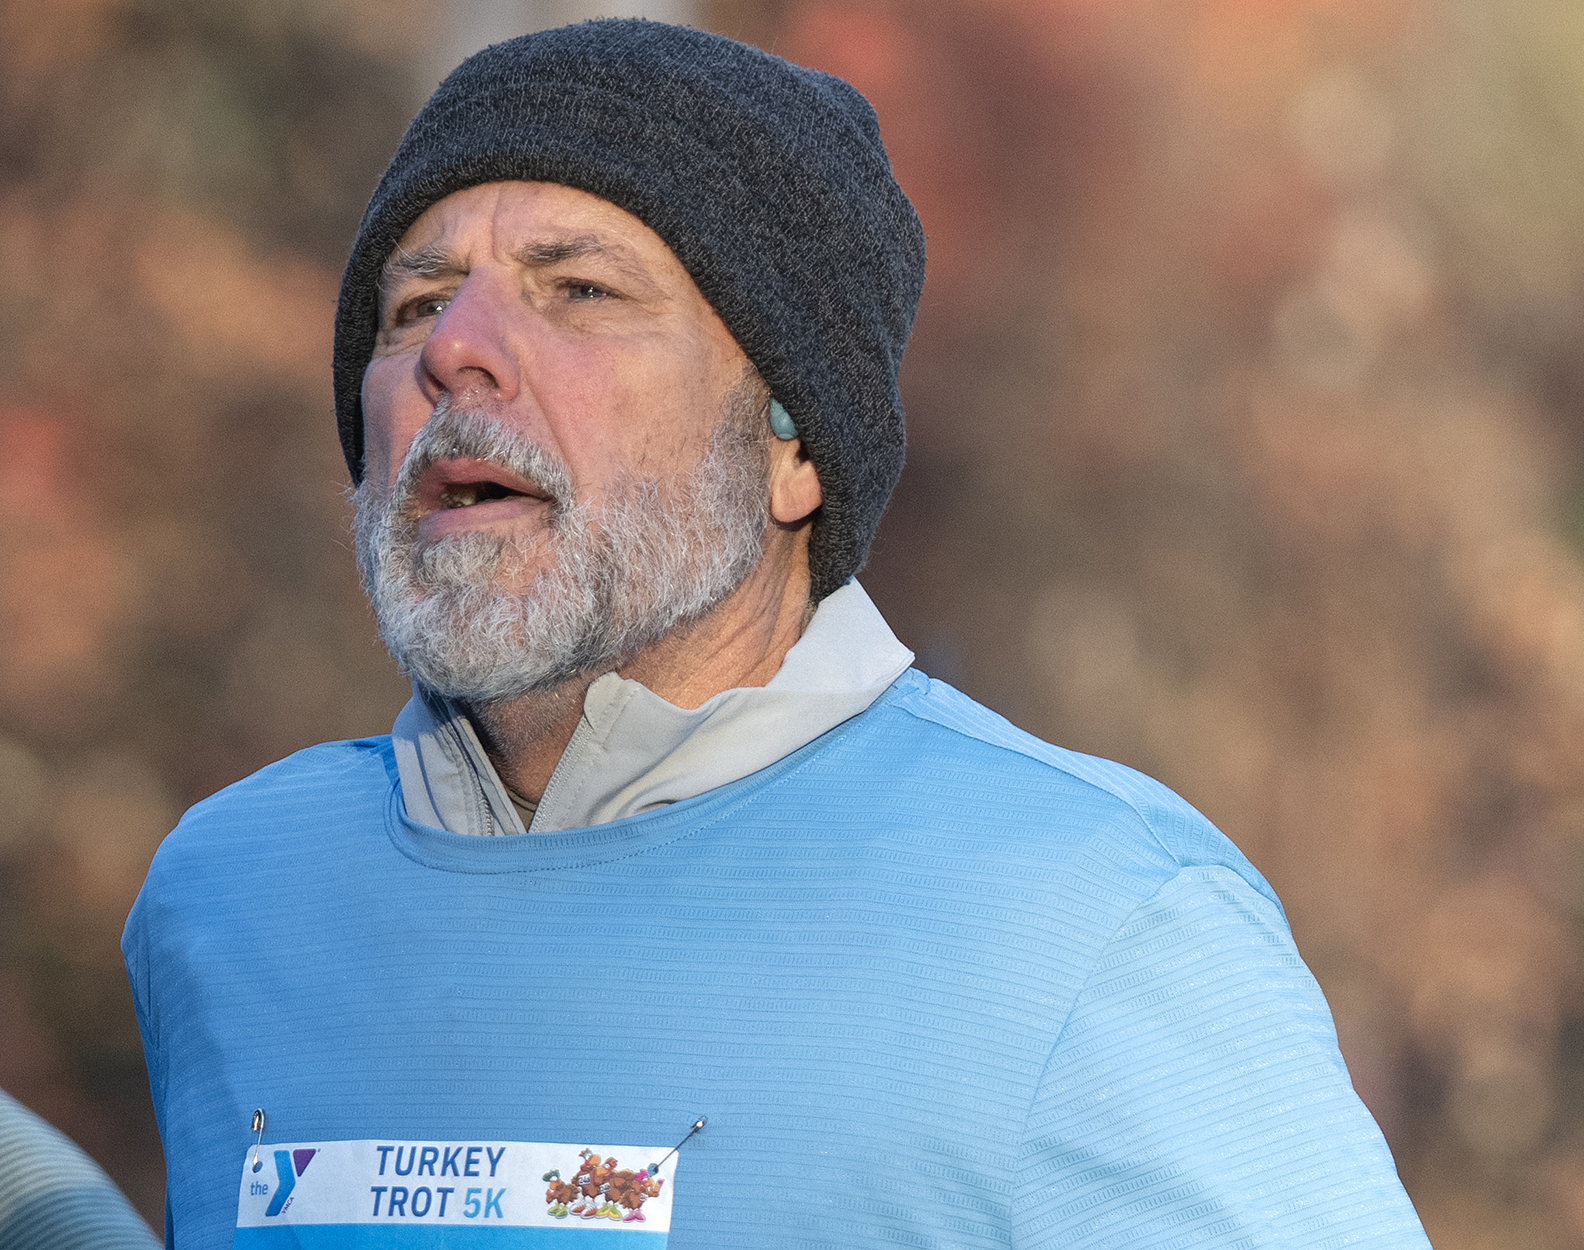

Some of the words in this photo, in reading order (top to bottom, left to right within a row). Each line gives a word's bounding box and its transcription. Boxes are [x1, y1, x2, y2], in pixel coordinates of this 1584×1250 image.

[376, 1145, 507, 1178] TURKEY
[250, 1180, 269, 1196] the
[281, 1196, 295, 1214] YMCA
[370, 1185, 455, 1218] TROT
[463, 1187, 507, 1219] 5K
